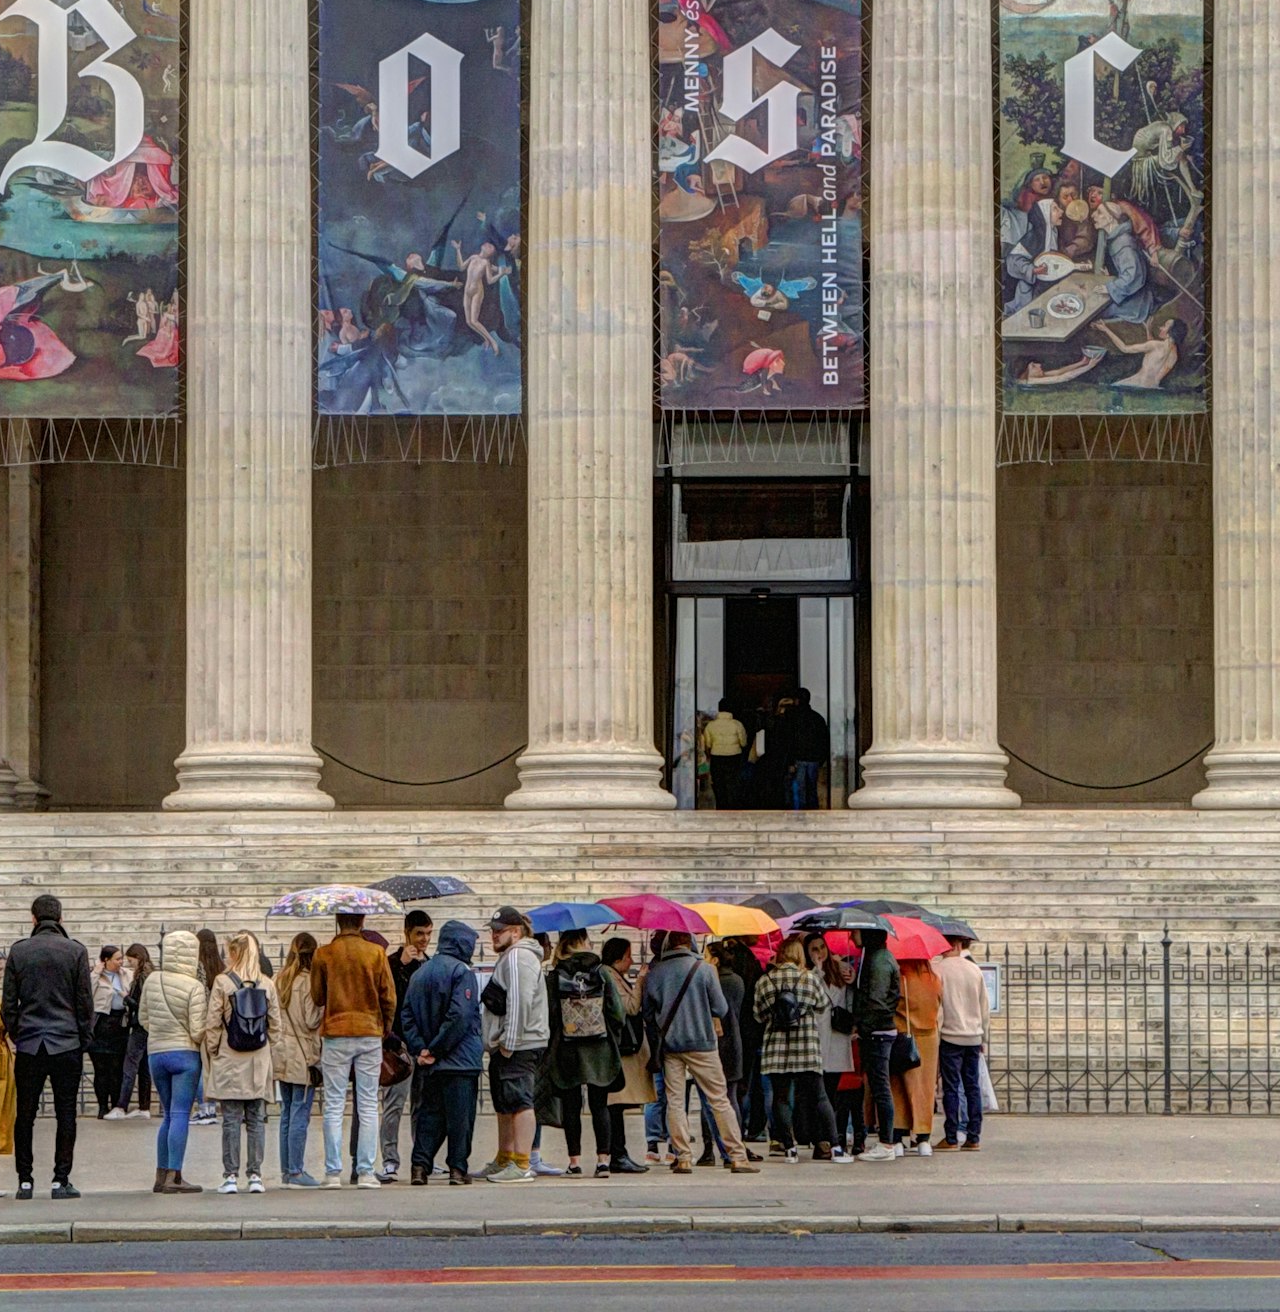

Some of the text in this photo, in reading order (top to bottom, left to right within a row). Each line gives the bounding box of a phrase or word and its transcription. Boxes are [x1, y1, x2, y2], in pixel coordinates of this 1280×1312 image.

[680, 0, 700, 21] és
[684, 28, 700, 112] MENNY
[817, 46, 839, 385] BETWEEN HELL and PARADISE
